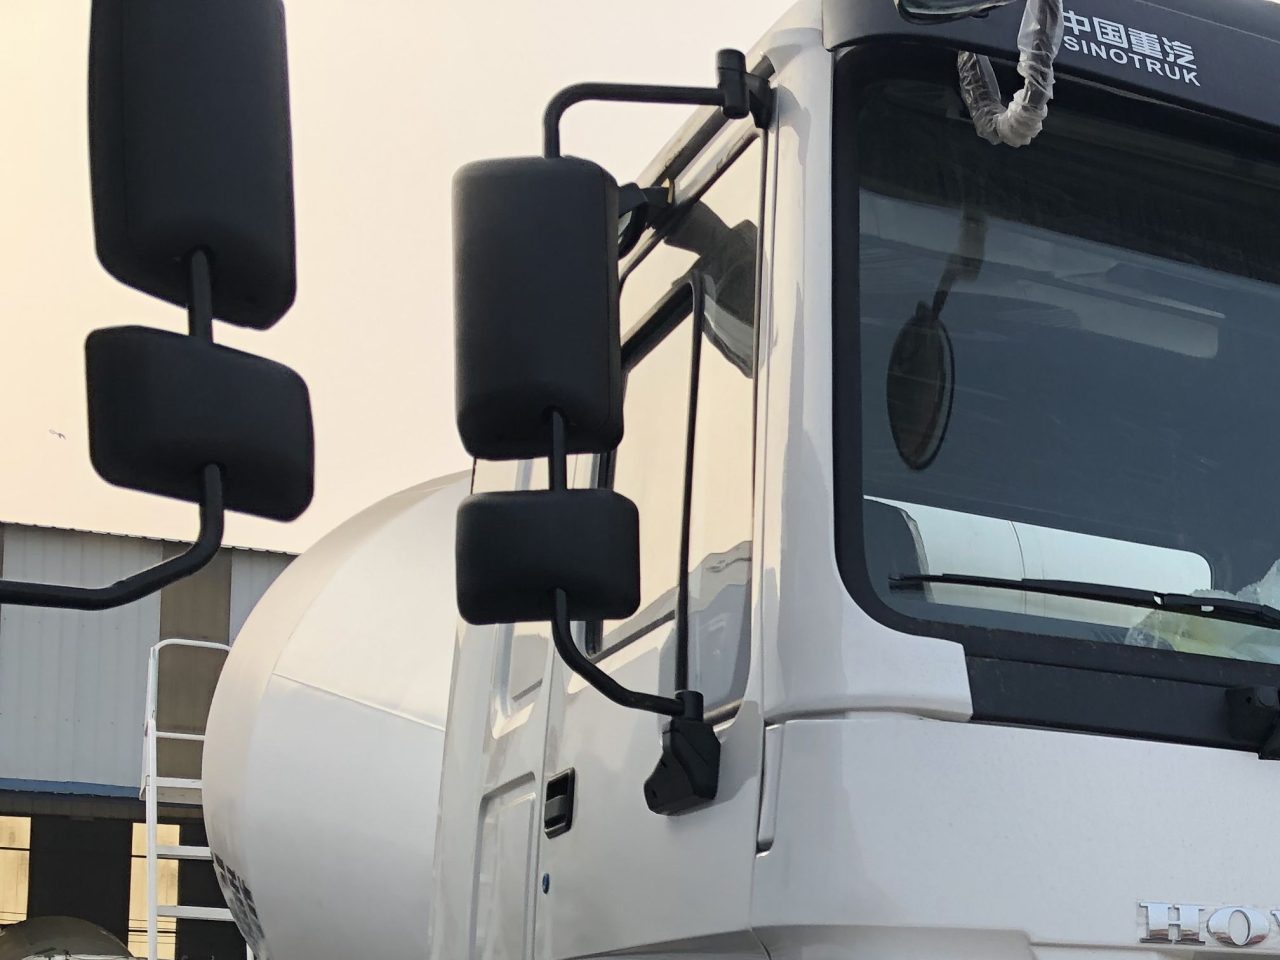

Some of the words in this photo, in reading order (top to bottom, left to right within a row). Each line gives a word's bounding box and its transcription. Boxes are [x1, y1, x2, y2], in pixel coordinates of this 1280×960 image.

[1062, 10, 1197, 69] 中国重汽
[1063, 35, 1201, 87] SINOTRUK
